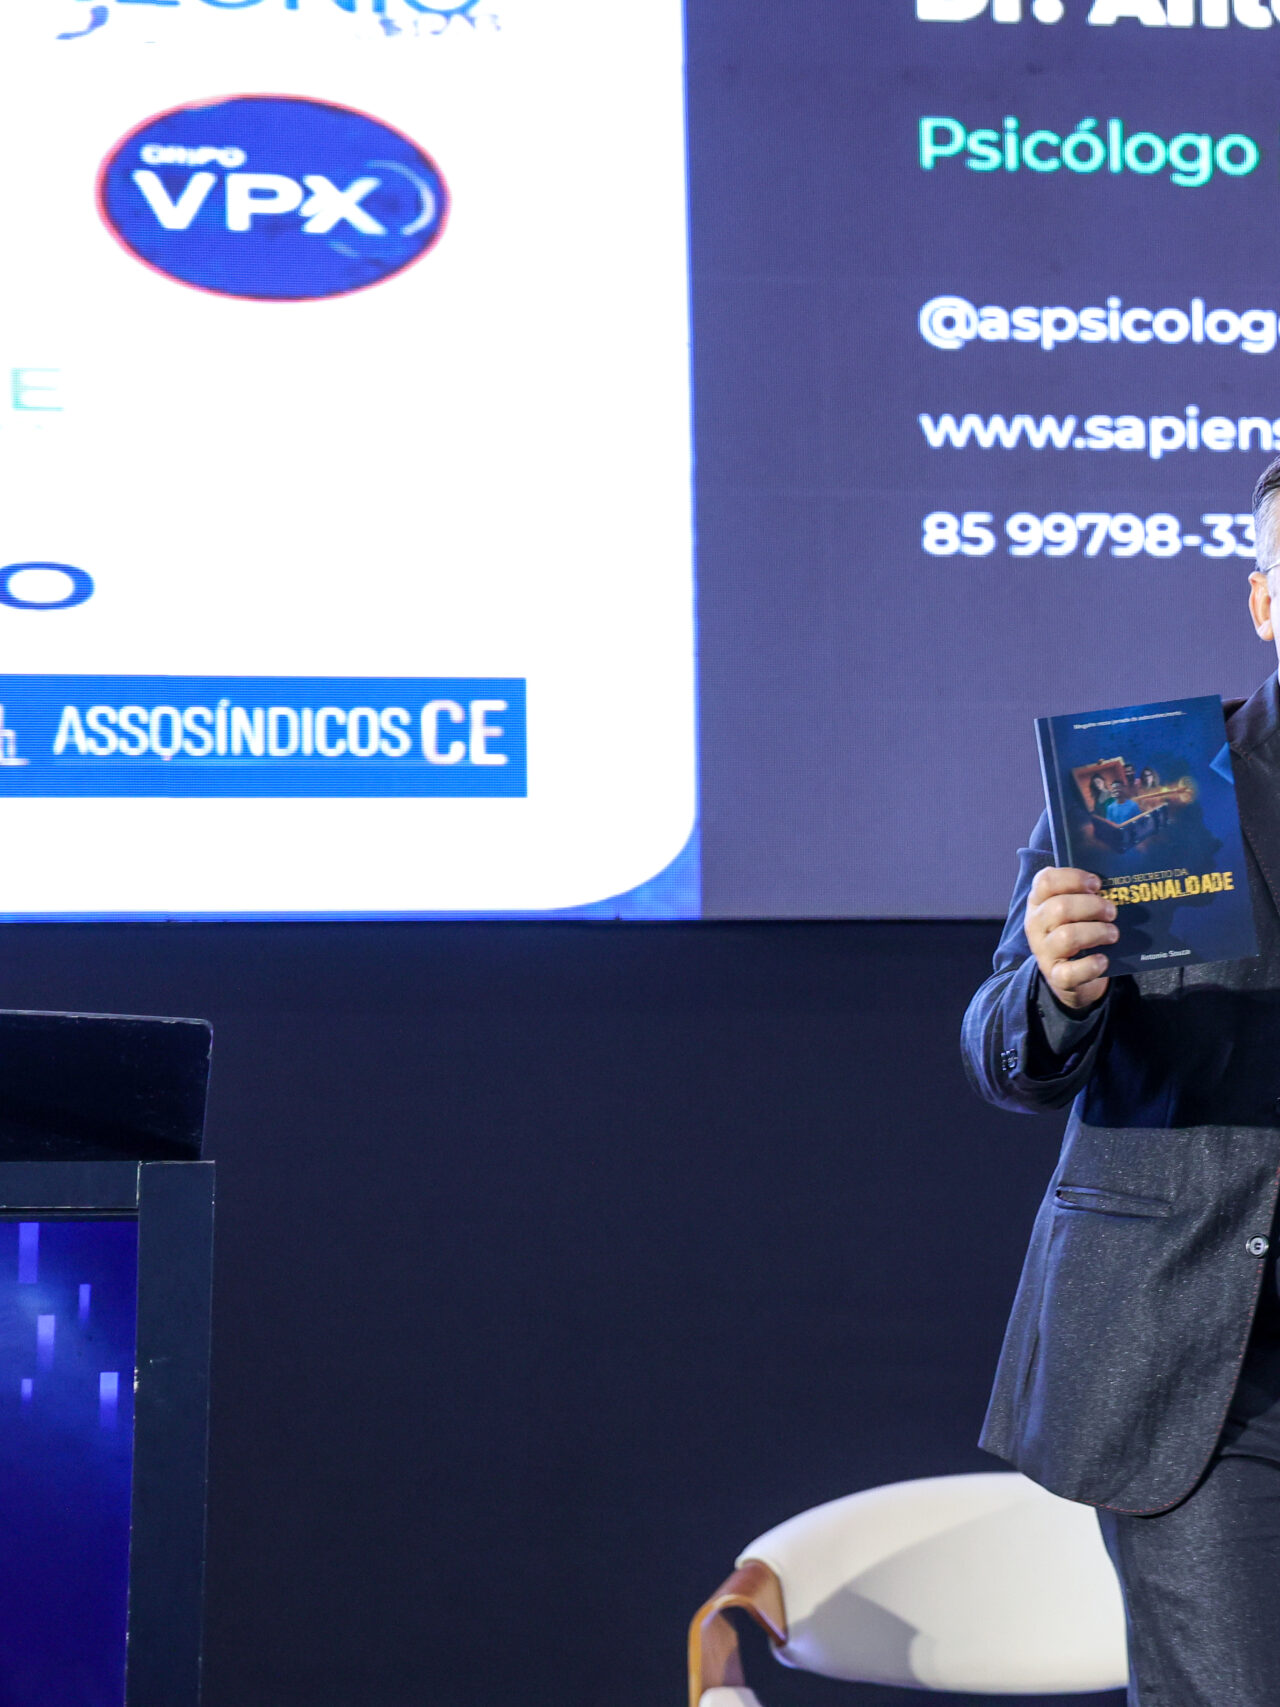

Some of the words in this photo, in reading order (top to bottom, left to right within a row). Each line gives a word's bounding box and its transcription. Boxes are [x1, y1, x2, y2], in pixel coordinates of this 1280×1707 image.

[918, 115, 1260, 188] Psicólogo
[132, 168, 388, 235] VPX
[921, 511, 996, 557] 85
[420, 699, 509, 766] CE
